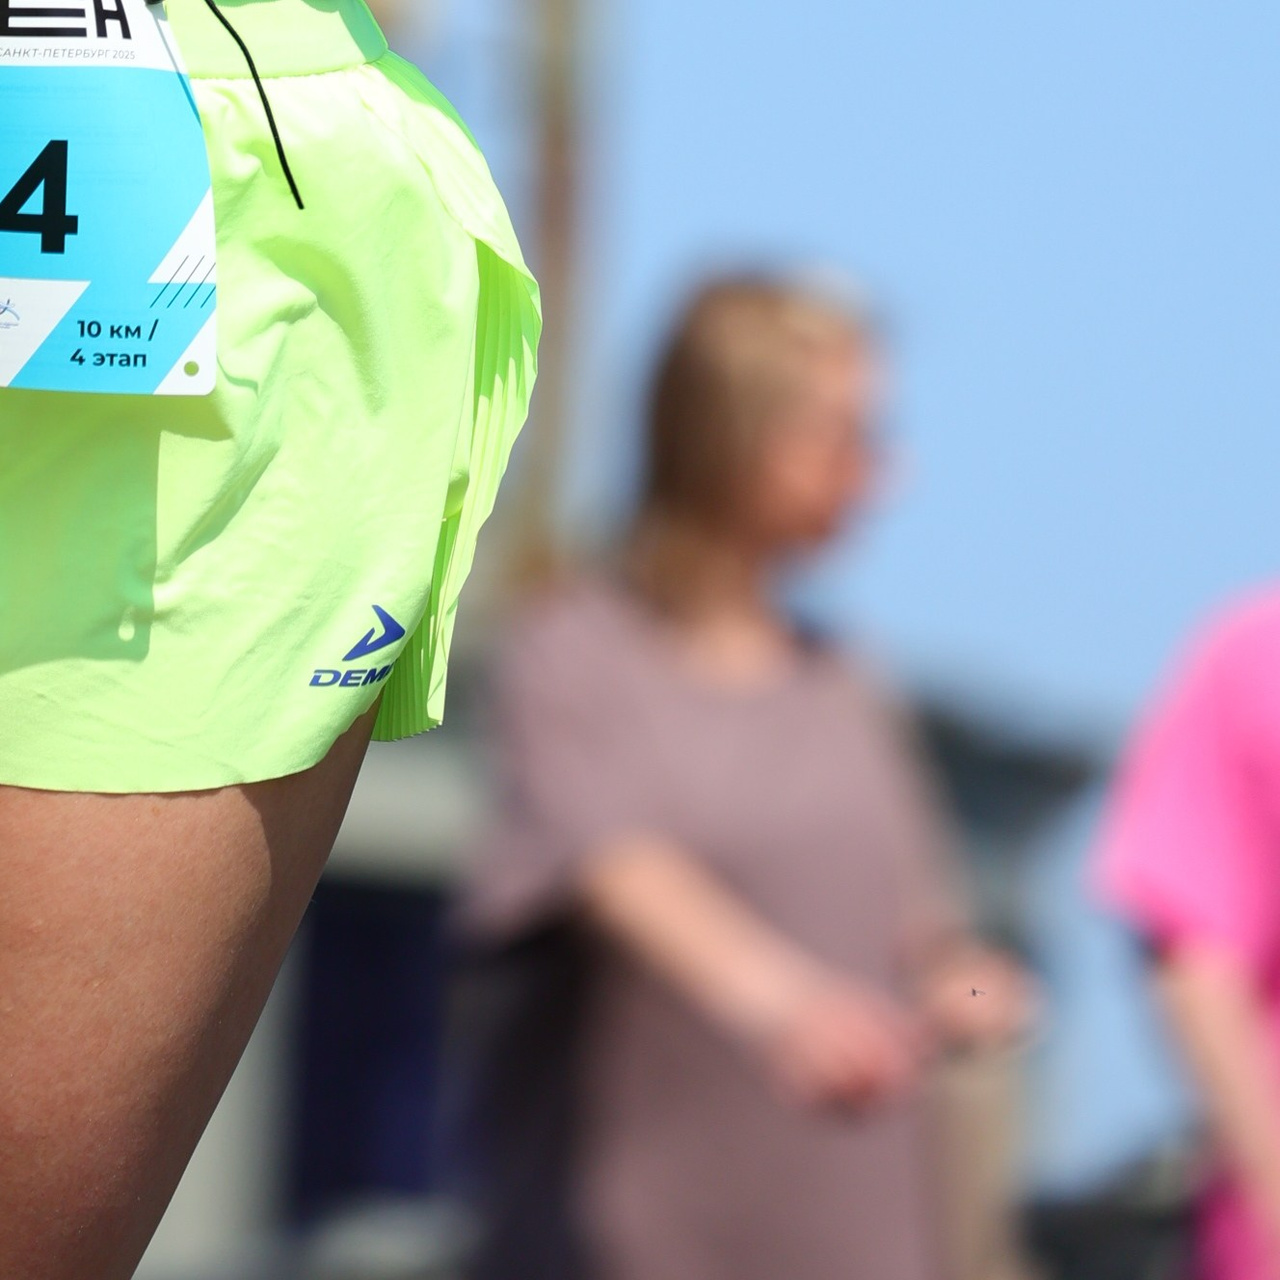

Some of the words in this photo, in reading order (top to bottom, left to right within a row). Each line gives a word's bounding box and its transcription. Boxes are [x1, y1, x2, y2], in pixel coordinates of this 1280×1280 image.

[112, 49, 136, 60] 2025
[77, 320, 102, 338] 10
[109, 325, 141, 339] км
[148, 318, 159, 341] /
[70, 348, 85, 365] 4
[92, 352, 147, 367] этап
